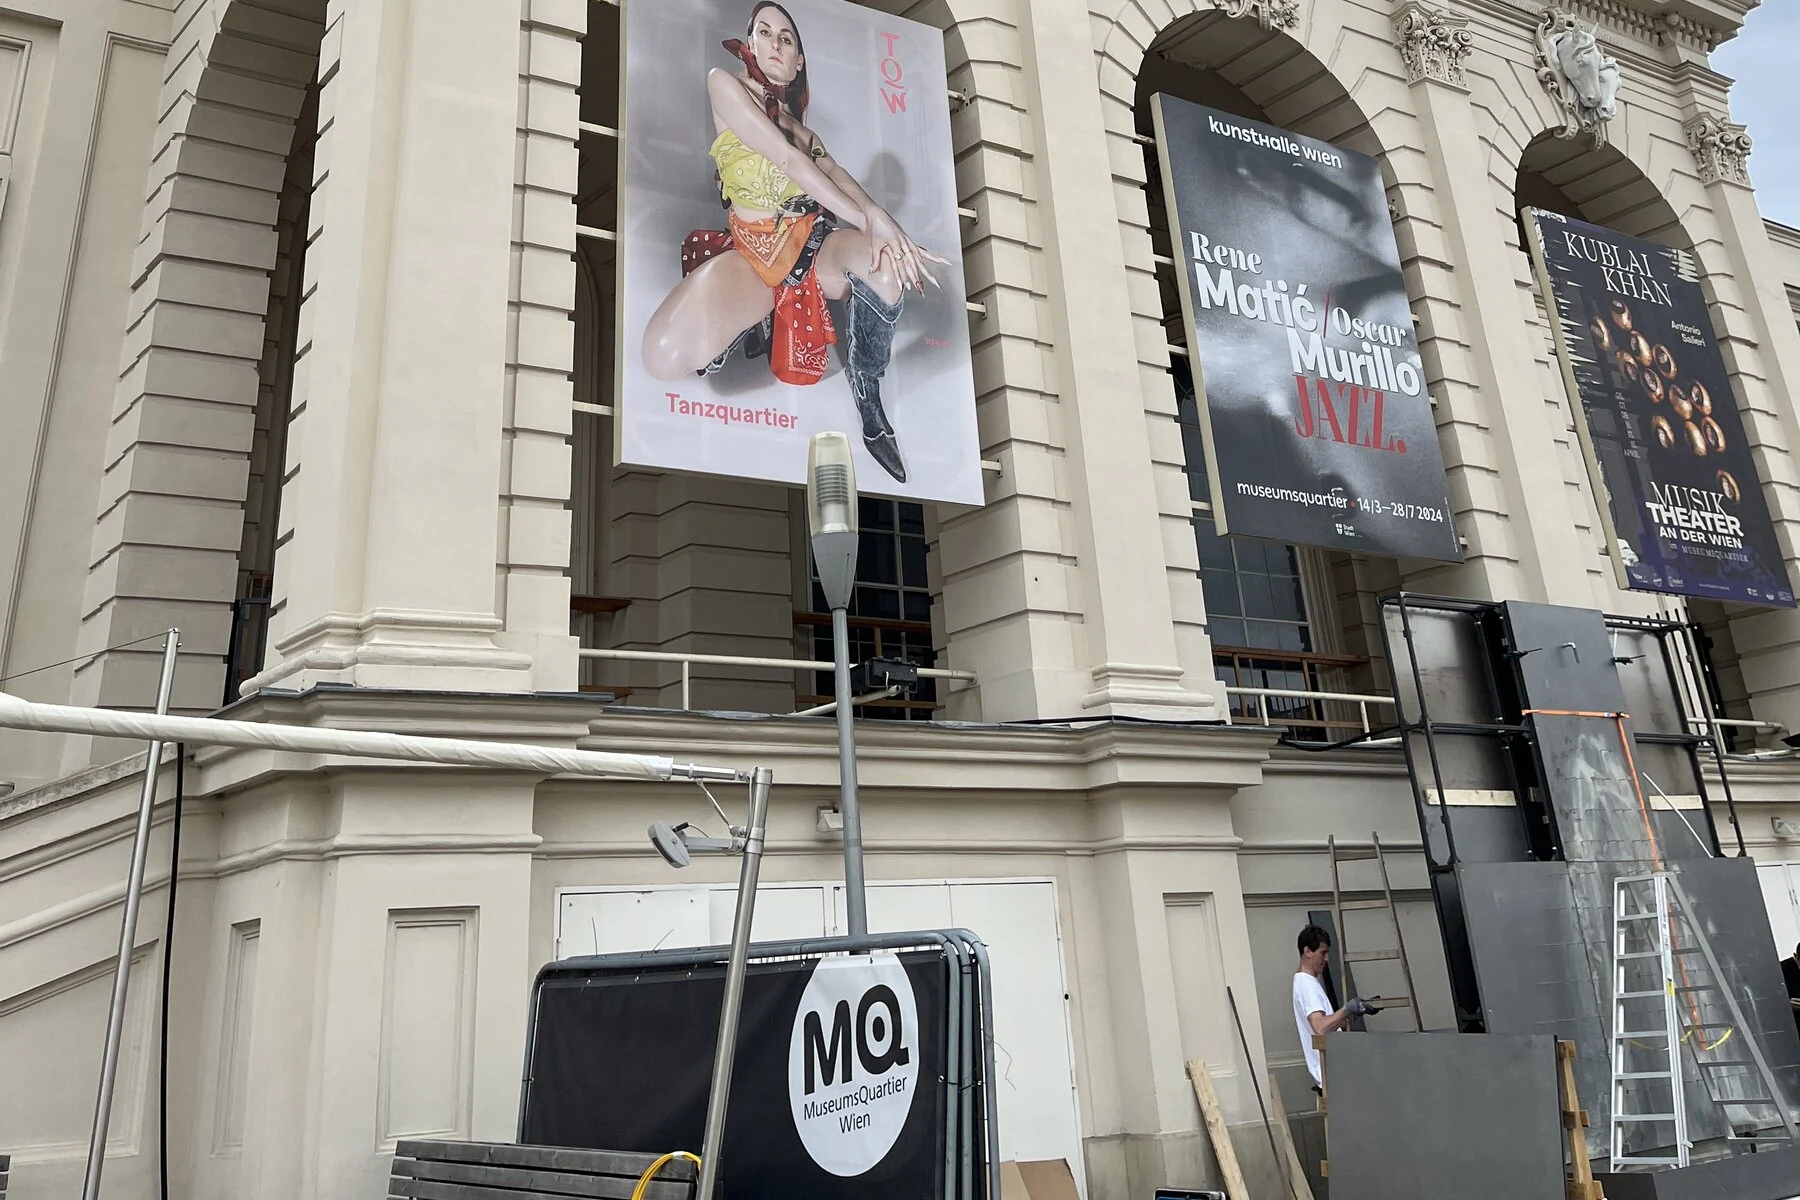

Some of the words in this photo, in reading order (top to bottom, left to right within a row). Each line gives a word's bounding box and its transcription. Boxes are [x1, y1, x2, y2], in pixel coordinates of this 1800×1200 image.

[880, 31, 907, 114] TQW
[1189, 231, 1263, 274] Rene
[1562, 231, 1653, 278] KUBLAI
[1194, 262, 1318, 332] Matić
[1332, 306, 1406, 347] Oscar
[1600, 266, 1673, 307] KHAN
[1671, 320, 1701, 335] Antonio
[1681, 333, 1706, 347] Salieri
[1286, 326, 1421, 397] Murillo
[665, 392, 798, 429] Tanzquartier
[1292, 373, 1407, 454] JAZZ.
[1237, 481, 1348, 509] museumsquartier
[1416, 505, 1444, 522] 2024
[1645, 501, 1745, 536] THEATER
[1650, 481, 1728, 517] MUSIK
[1660, 526, 1678, 539] AN
[1680, 529, 1708, 544] DER
[1708, 533, 1743, 549] WIEN
[1681, 545, 1749, 562] MUSEUMSQUARTIER
[803, 984, 910, 1096] MQ
[803, 1075, 908, 1121] MuseumsQuartier
[839, 1111, 871, 1135] Wien
